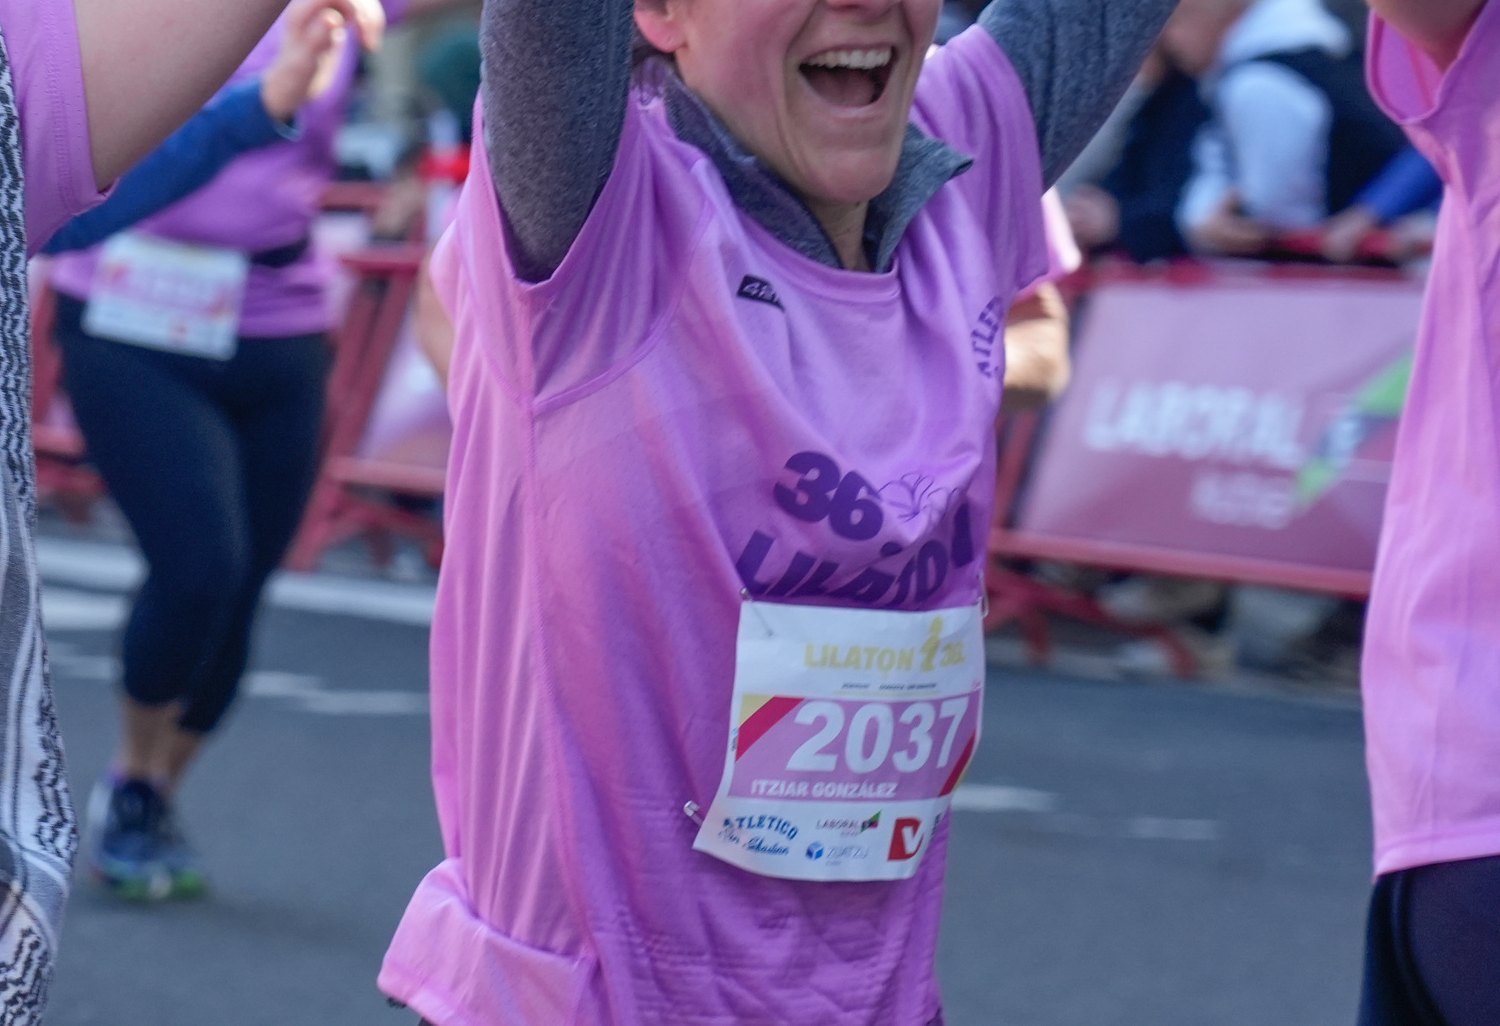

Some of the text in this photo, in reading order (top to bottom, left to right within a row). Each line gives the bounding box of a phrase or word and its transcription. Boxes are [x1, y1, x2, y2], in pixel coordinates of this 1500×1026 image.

[804, 643, 915, 676] LILATON
[785, 696, 970, 774] 2037
[751, 779, 899, 798] ITZIAR GONZÁLEZ
